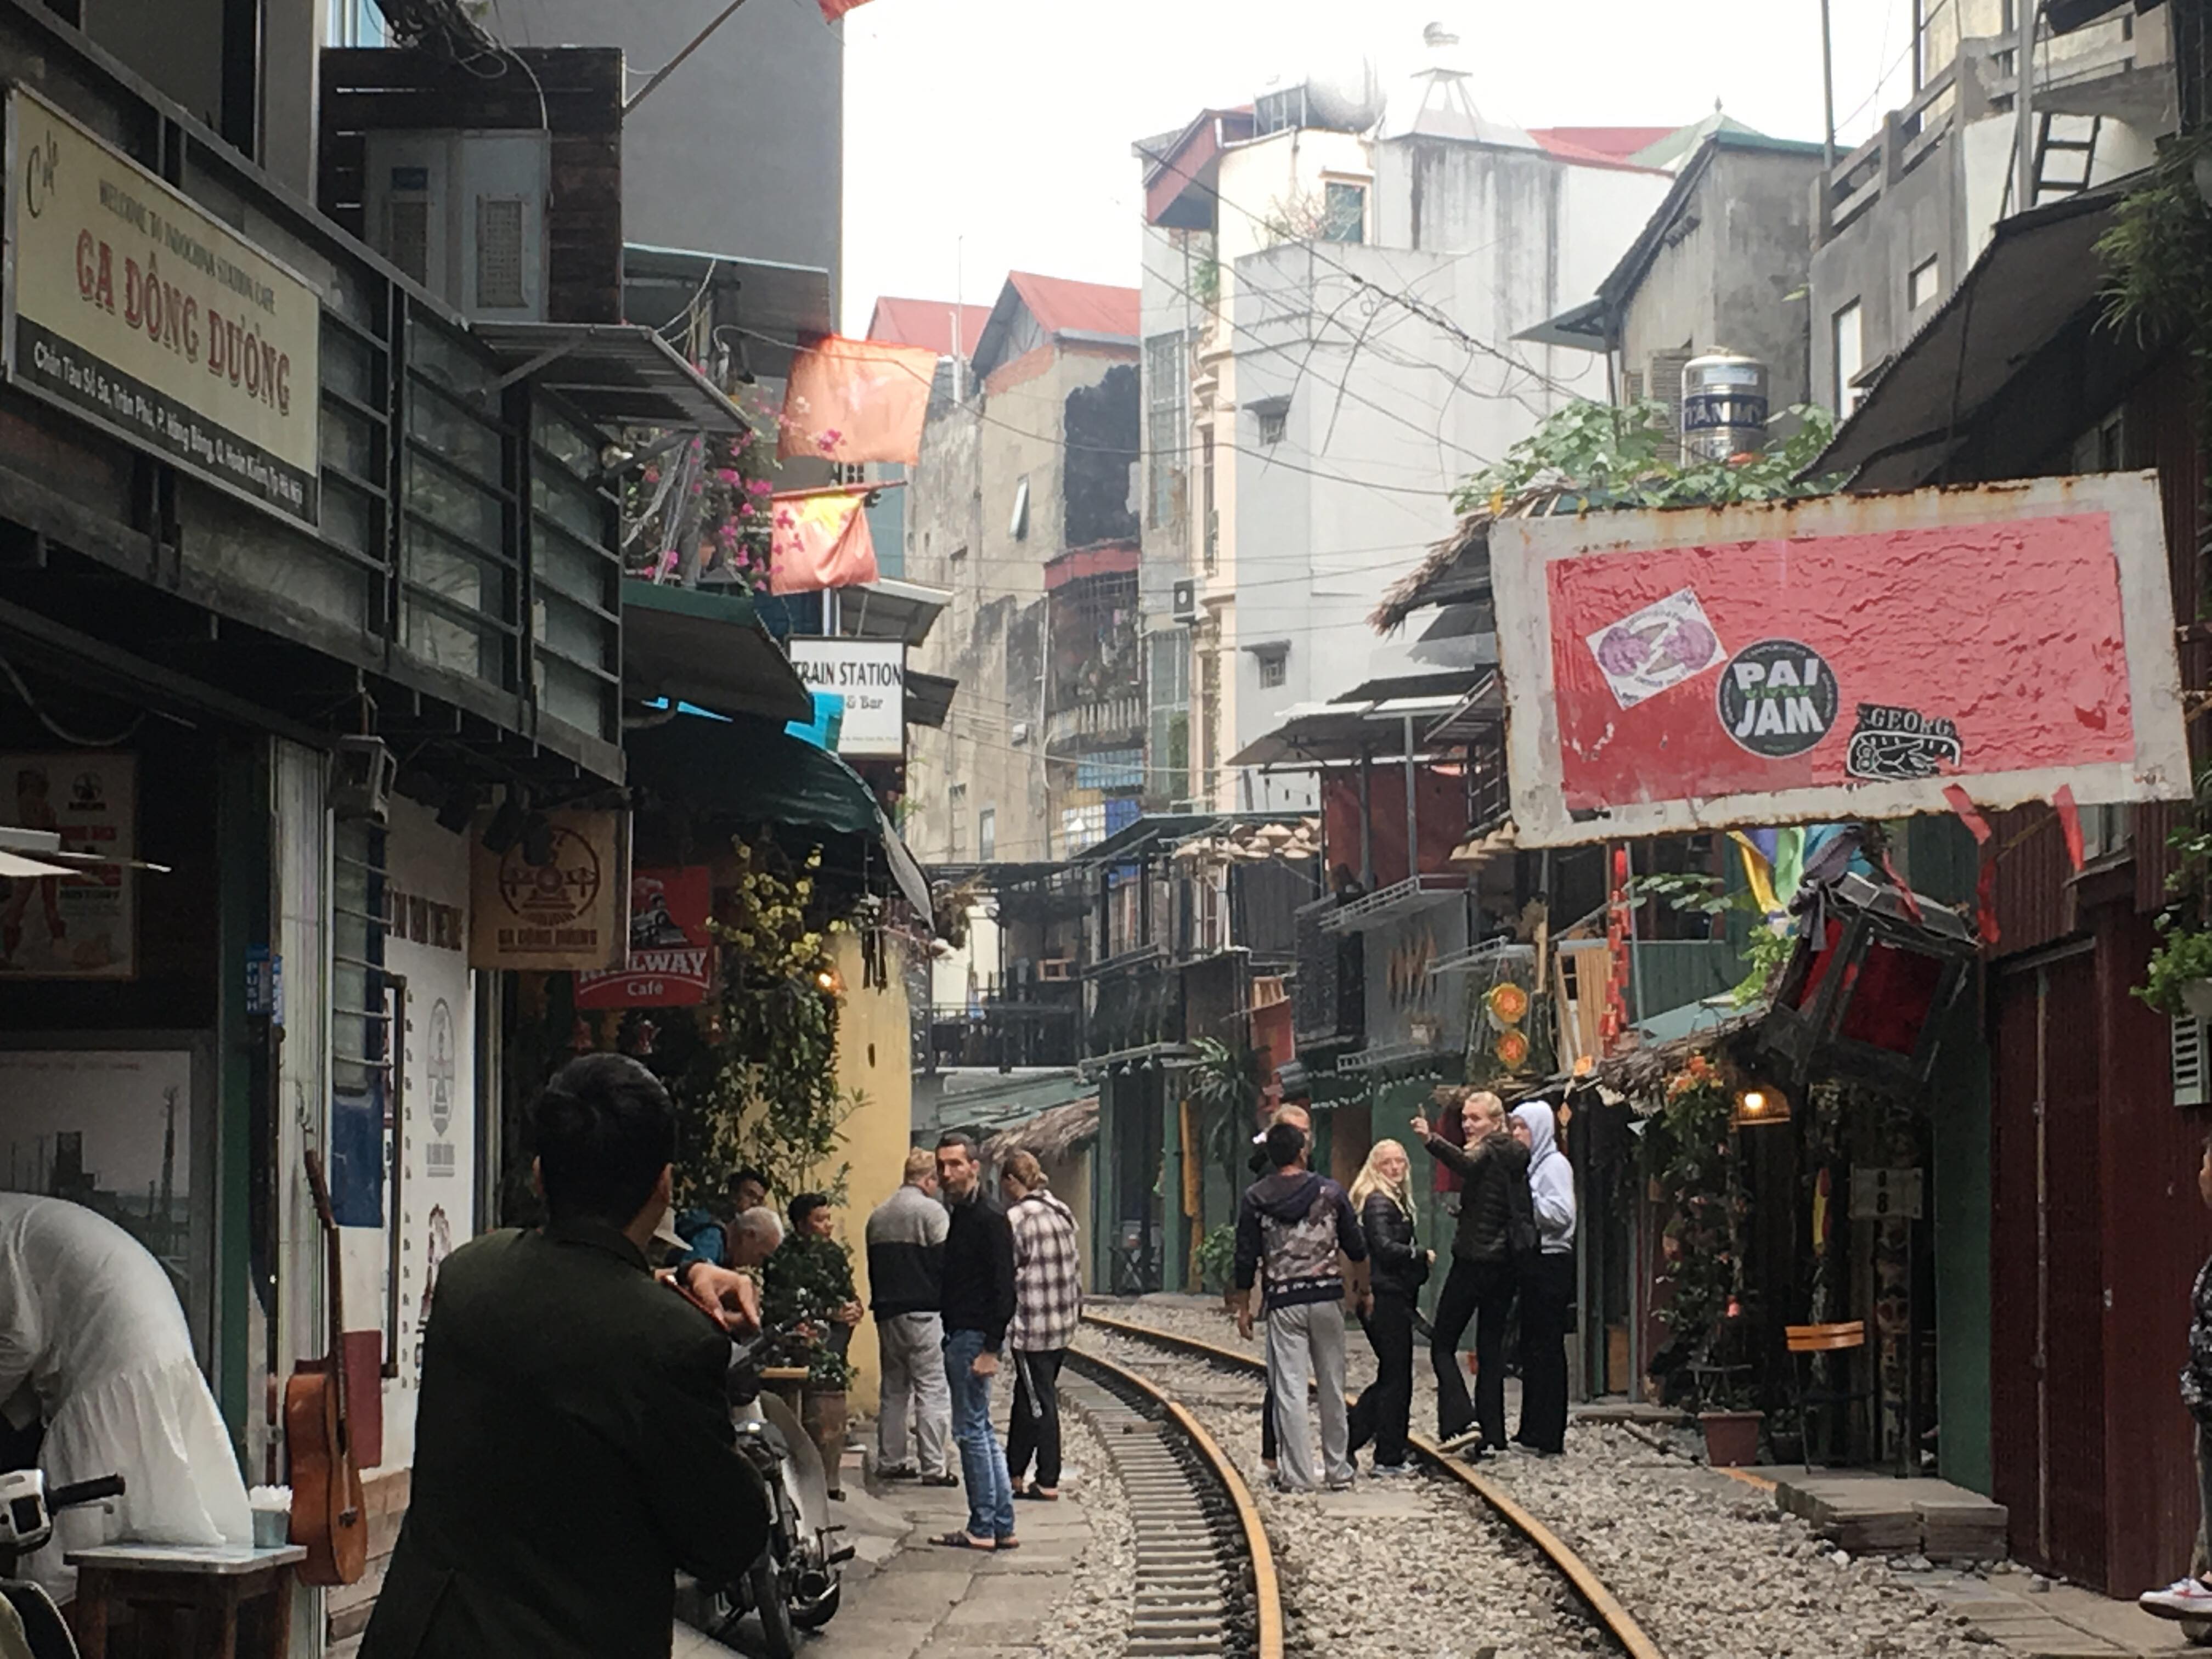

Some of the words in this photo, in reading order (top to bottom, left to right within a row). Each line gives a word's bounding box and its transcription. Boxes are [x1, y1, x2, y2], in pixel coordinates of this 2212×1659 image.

[77, 228, 115, 315] GA
[839, 661, 903, 686] STATION
[1733, 658, 1819, 690] PAI
[860, 695, 883, 709] Bar
[1735, 697, 1825, 737] JAM
